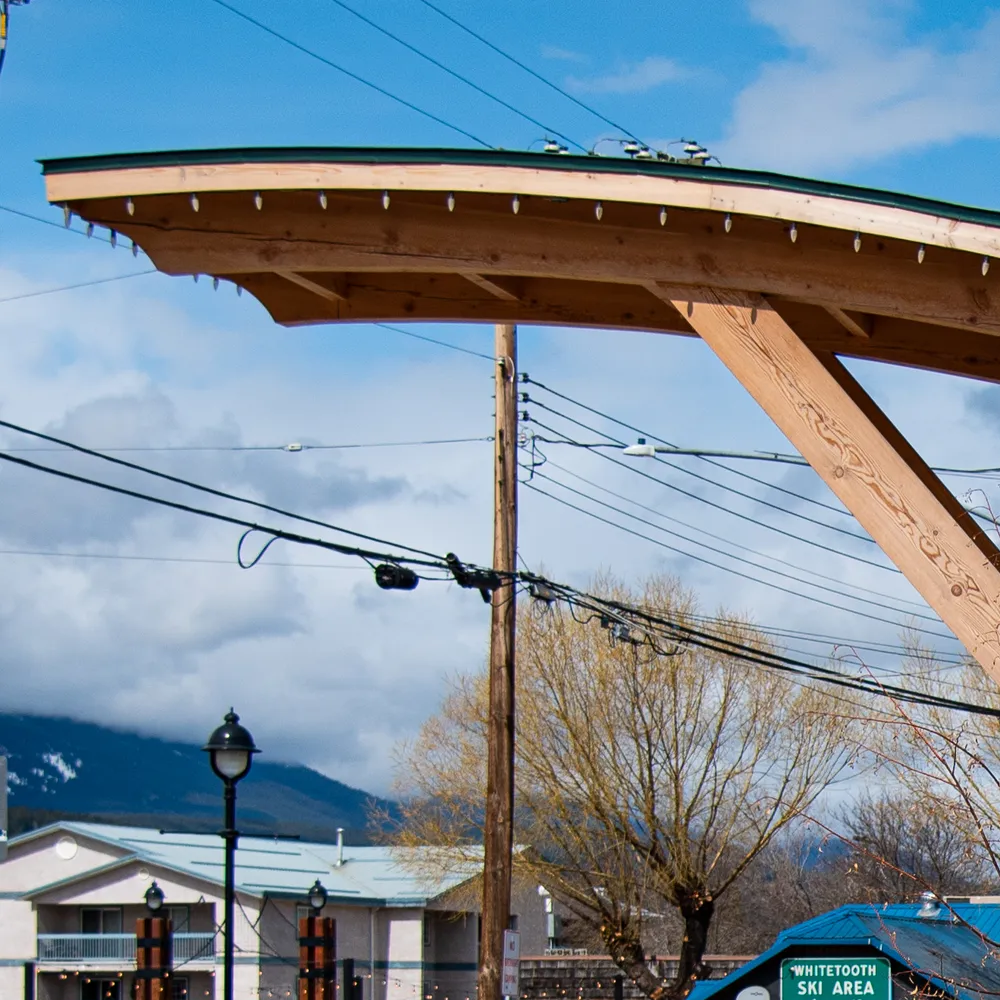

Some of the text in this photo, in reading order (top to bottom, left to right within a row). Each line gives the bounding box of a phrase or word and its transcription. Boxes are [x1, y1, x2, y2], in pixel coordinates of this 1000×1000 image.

[794, 964, 876, 976] WHITETOOTH
[797, 981, 874, 995] SKI AREA
